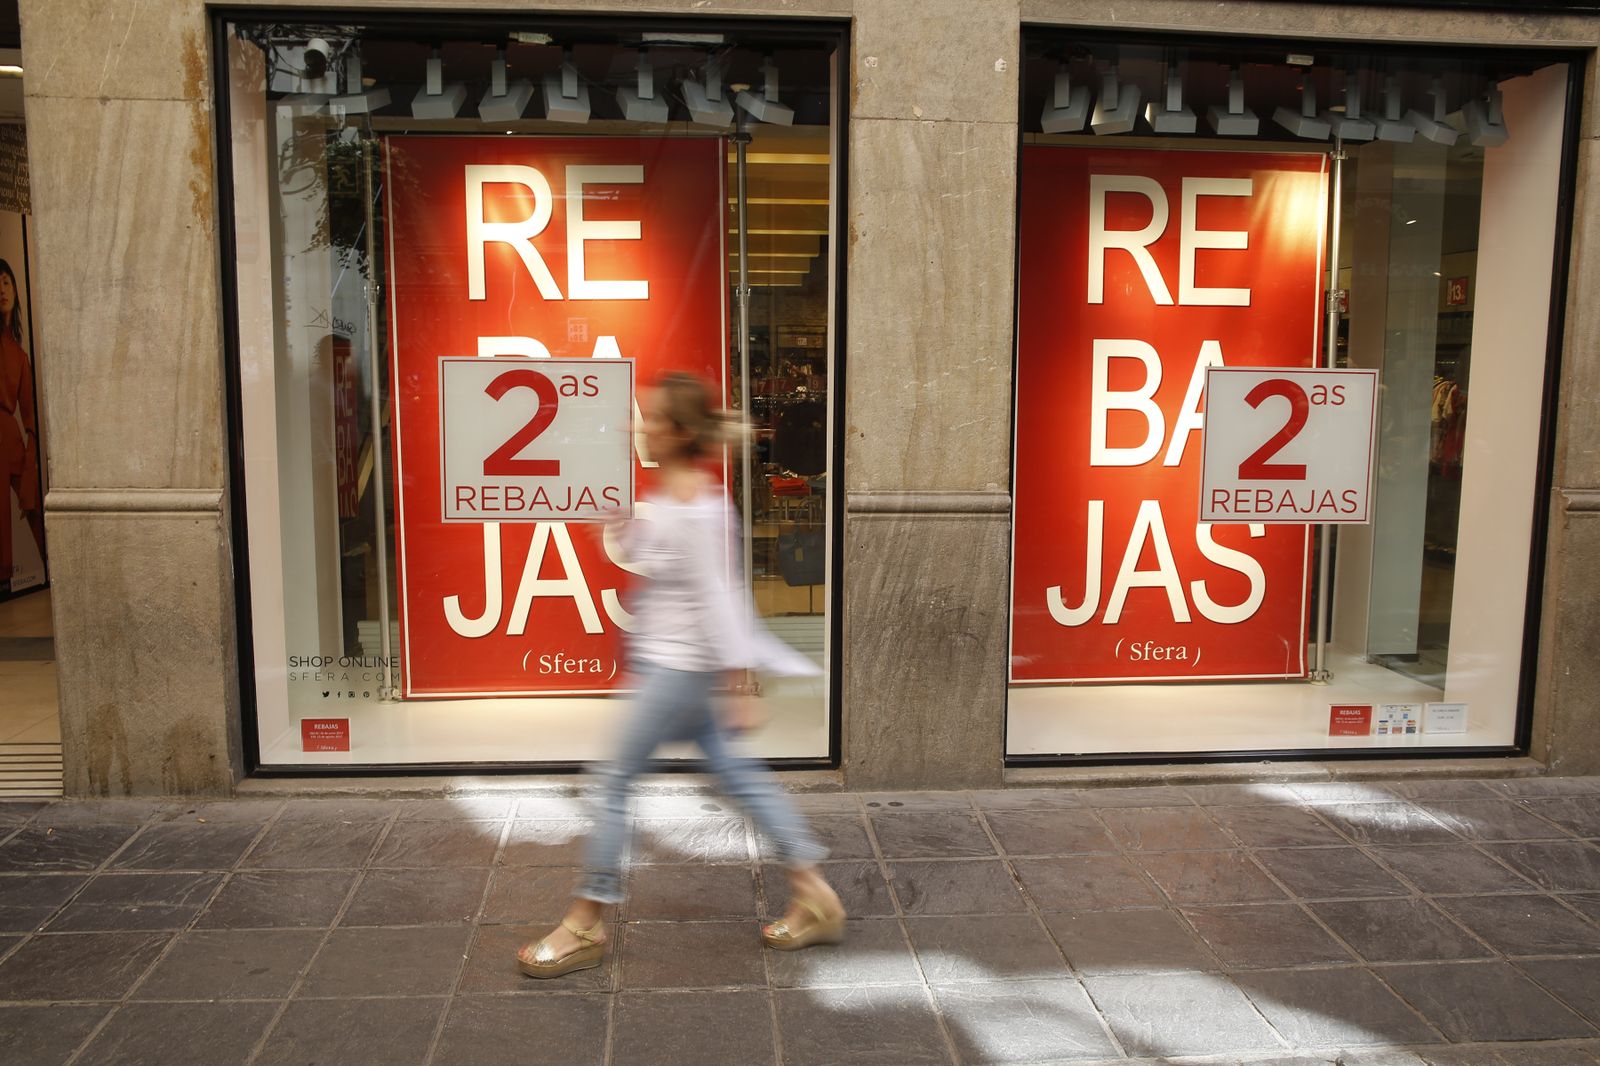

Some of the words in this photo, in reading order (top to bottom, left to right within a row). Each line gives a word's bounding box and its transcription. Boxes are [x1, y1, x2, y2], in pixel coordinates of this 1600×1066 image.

[464, 164, 649, 301] RE
[1087, 174, 1253, 306] RE
[455, 486, 621, 511] REBAJAS
[1211, 489, 1358, 514] REBAJAS
[1046, 500, 1266, 627] JAS
[289, 655, 334, 668] SHOP
[338, 655, 399, 668] ONLINE
